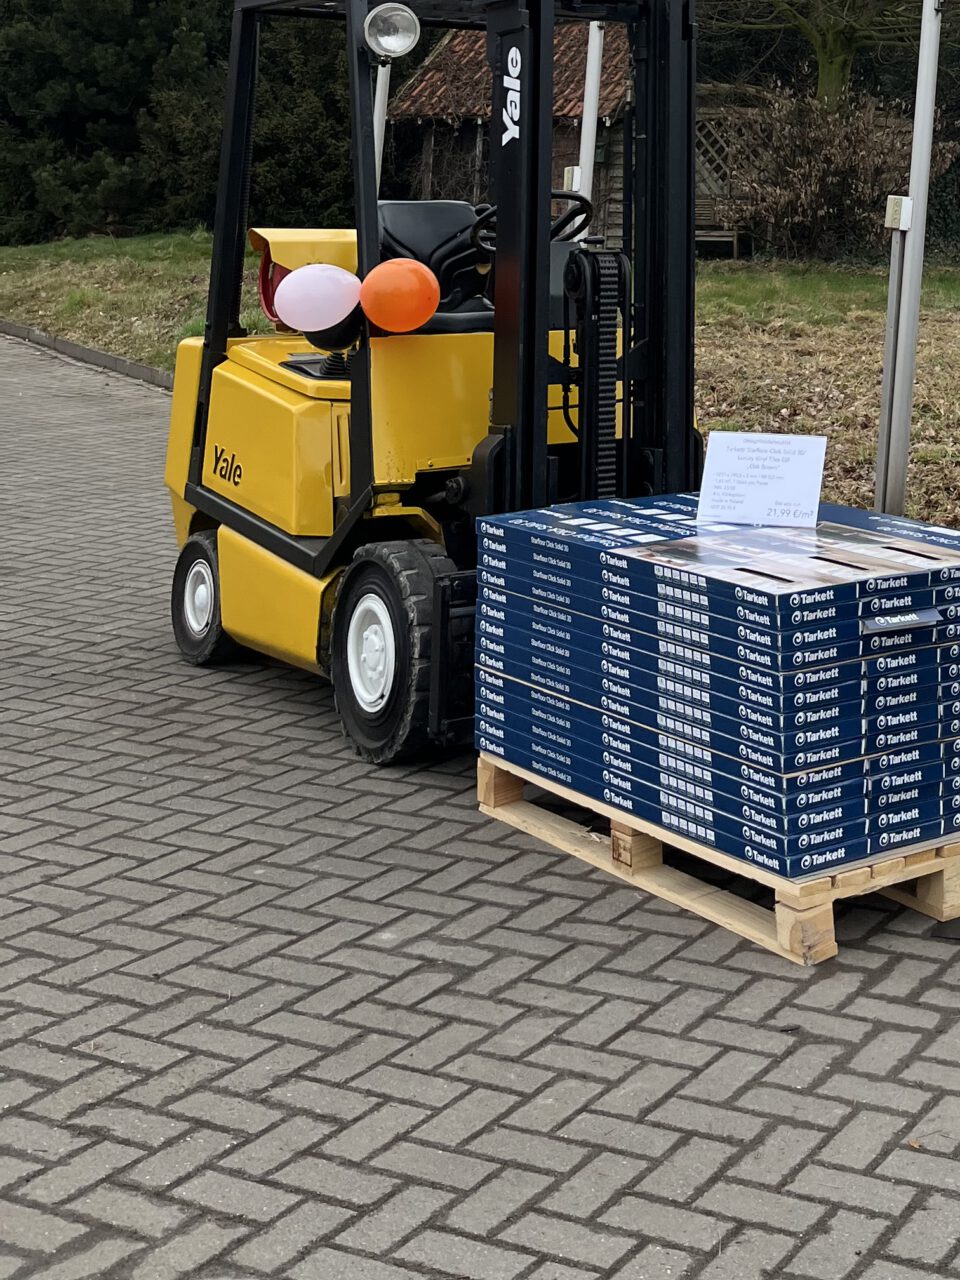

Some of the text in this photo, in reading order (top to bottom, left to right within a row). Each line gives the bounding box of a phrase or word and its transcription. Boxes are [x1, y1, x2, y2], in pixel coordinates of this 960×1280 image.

[502, 47, 521, 147] Yale
[213, 445, 242, 486] Yale
[766, 508, 790, 518] 21,99
[486, 523, 504, 536] Tarkett
[488, 539, 506, 553] Tarkett
[488, 555, 506, 569] Tarkett
[606, 555, 628, 569] Tarkett
[487, 573, 505, 586] Tarkett
[609, 573, 630, 587] Tarkett
[876, 577, 908, 590] Tarkett
[488, 589, 506, 603] Tarkett
[609, 591, 630, 605] Tarkett
[743, 589, 768, 607] Tarkett
[801, 590, 834, 605] Tarkett
[880, 596, 912, 610] Tarkett
[486, 605, 505, 620] Tarkett
[608, 609, 629, 623] Tarkett
[744, 609, 771, 626] Tarkett
[803, 607, 836, 621] Tarkett
[886, 613, 919, 624] Tarkett
[486, 622, 503, 637] Tarkett
[609, 627, 631, 642] Tarkett
[745, 629, 771, 646] Tarkett
[803, 627, 837, 642] Tarkett
[486, 638, 504, 654] Tarkett
[880, 634, 912, 647] Tarkett
[609, 645, 630, 661] Tarkett
[745, 648, 771, 666] Tarkett
[804, 648, 837, 662] Tarkett
[485, 654, 504, 670] Tarkett
[886, 654, 916, 669] Tarkett
[608, 663, 629, 679] Tarkett
[747, 669, 773, 687] Tarkett
[805, 668, 839, 683] Tarkett
[485, 672, 504, 688] Tarkett
[886, 674, 918, 688] Tarkett
[486, 689, 504, 704] Tarkett
[609, 682, 631, 697] Tarkett
[747, 688, 773, 707] Tarkett
[805, 688, 839, 703] Tarkett
[608, 697, 630, 716] Tarkett
[886, 692, 917, 707] Tarkett
[486, 705, 504, 721] Tarkett
[747, 708, 773, 726] Tarkett
[806, 707, 839, 722] Tarkett
[886, 712, 917, 726] Tarkett
[486, 722, 504, 738] Tarkett
[609, 718, 631, 734] Tarkett
[748, 728, 774, 747] Tarkett
[806, 727, 839, 743] Tarkett
[887, 731, 918, 745] Tarkett
[486, 739, 504, 755] Tarkett
[609, 736, 631, 753] Tarkett
[609, 754, 631, 772] Tarkett
[747, 748, 773, 766] Tarkett
[806, 748, 840, 763] Tarkett
[889, 750, 920, 765] Tarkett
[609, 773, 631, 791] Tarkett
[748, 768, 775, 787] Tarkett
[808, 767, 842, 783] Tarkett
[891, 771, 922, 786] Tarkett
[610, 792, 633, 810] Tarkett
[748, 788, 775, 808] Tarkett
[808, 787, 842, 804] Tarkett
[888, 789, 919, 804] Tarkett
[750, 809, 777, 829] Tarkett
[809, 808, 842, 824] Tarkett
[888, 808, 919, 824] Tarkett
[750, 829, 777, 850] Tarkett
[809, 828, 843, 845] Tarkett
[889, 828, 921, 843] Tarkett
[752, 849, 779, 870] Tarkett
[812, 848, 845, 866] Tarkett
